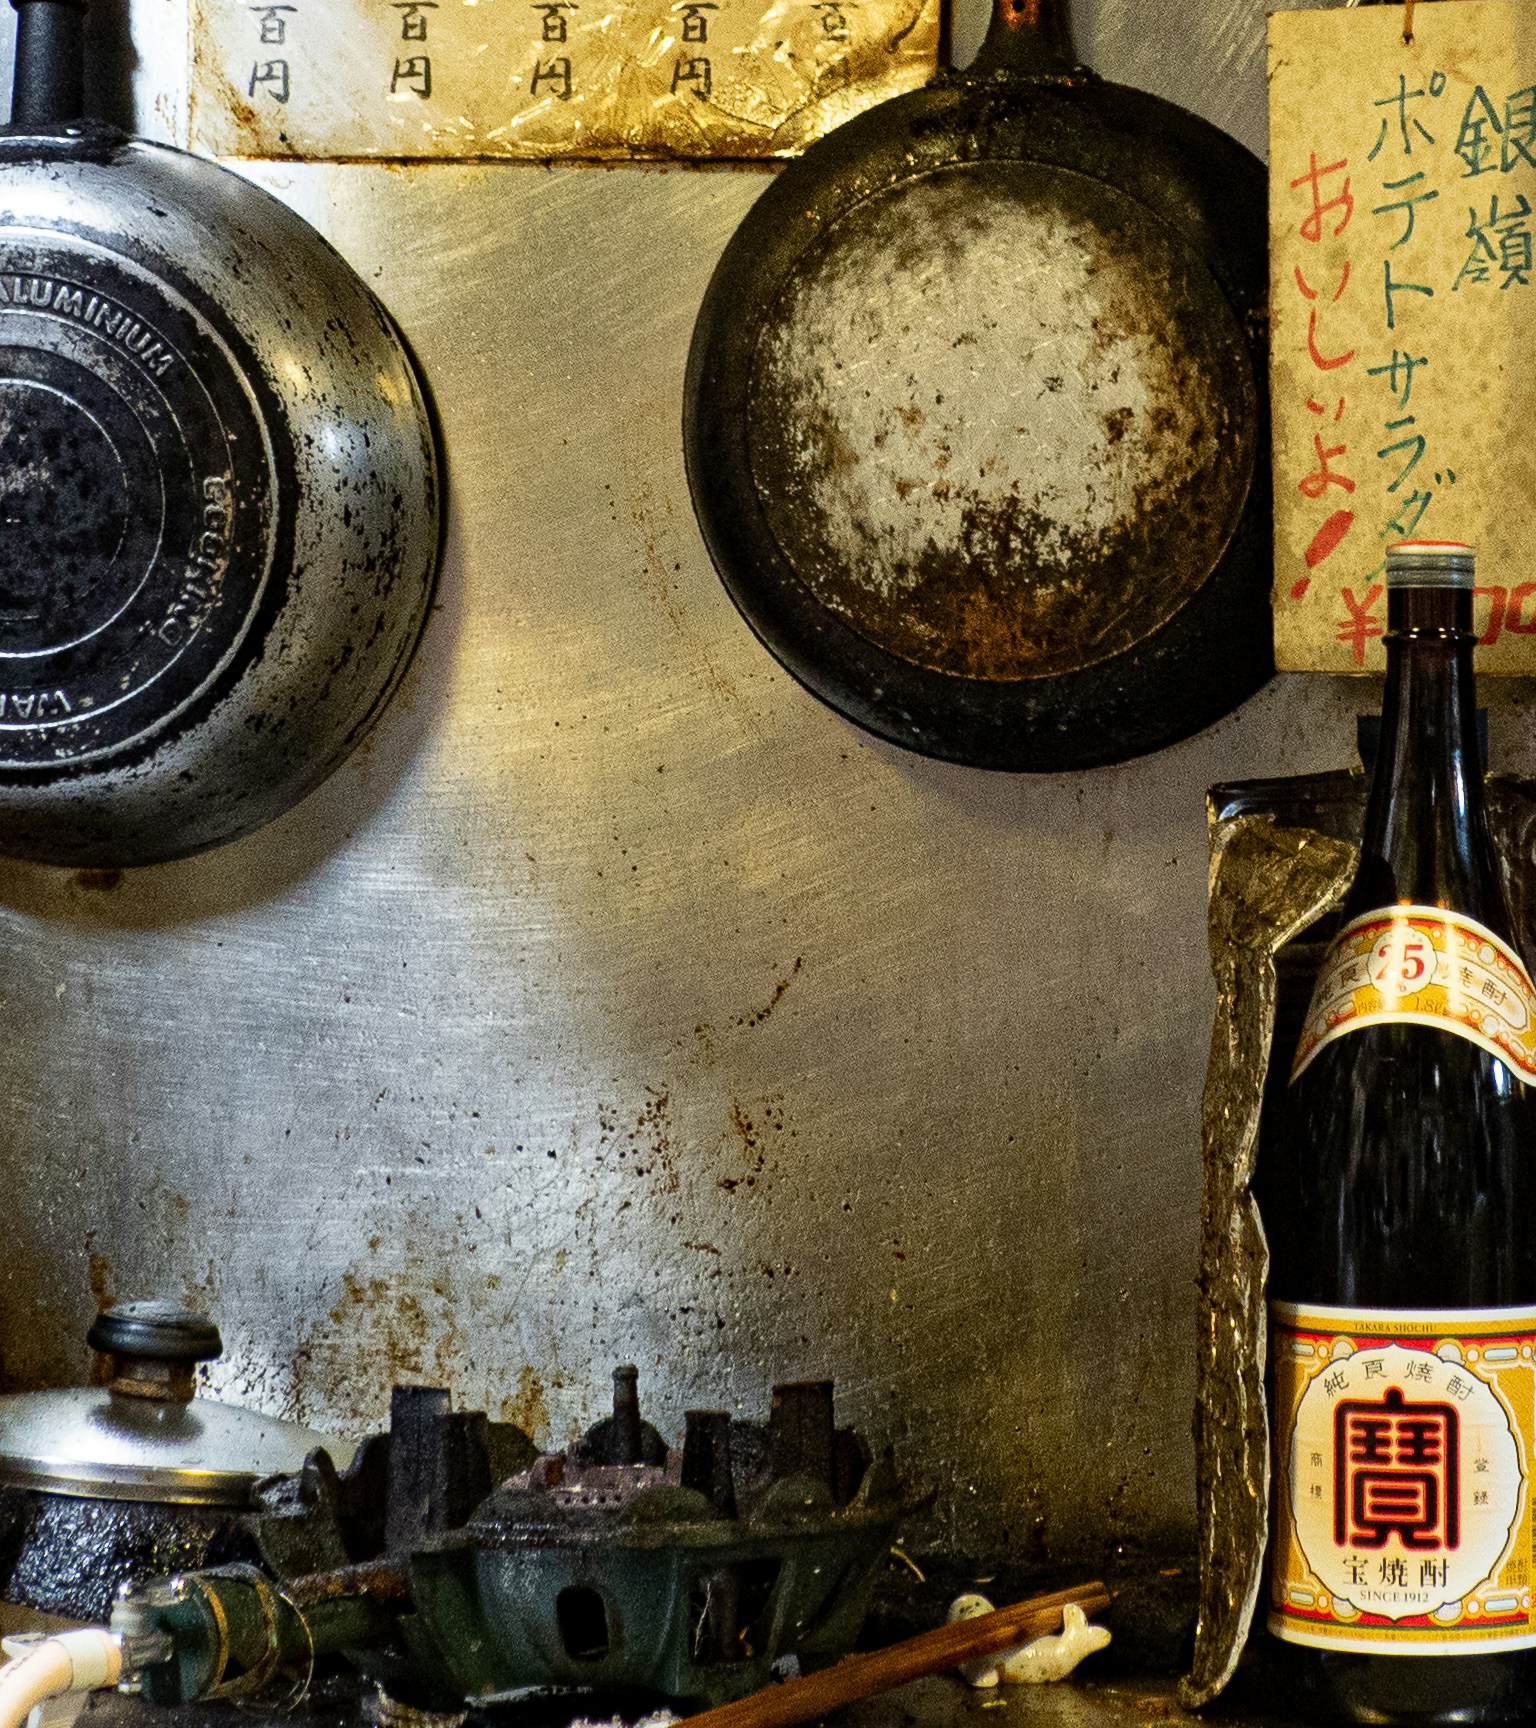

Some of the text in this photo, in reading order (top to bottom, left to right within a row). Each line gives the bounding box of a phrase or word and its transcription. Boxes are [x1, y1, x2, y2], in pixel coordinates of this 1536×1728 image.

[1342, 1555, 1452, 1589] 宝焼酎
[1359, 1589, 1431, 1604] SINCE 1912
